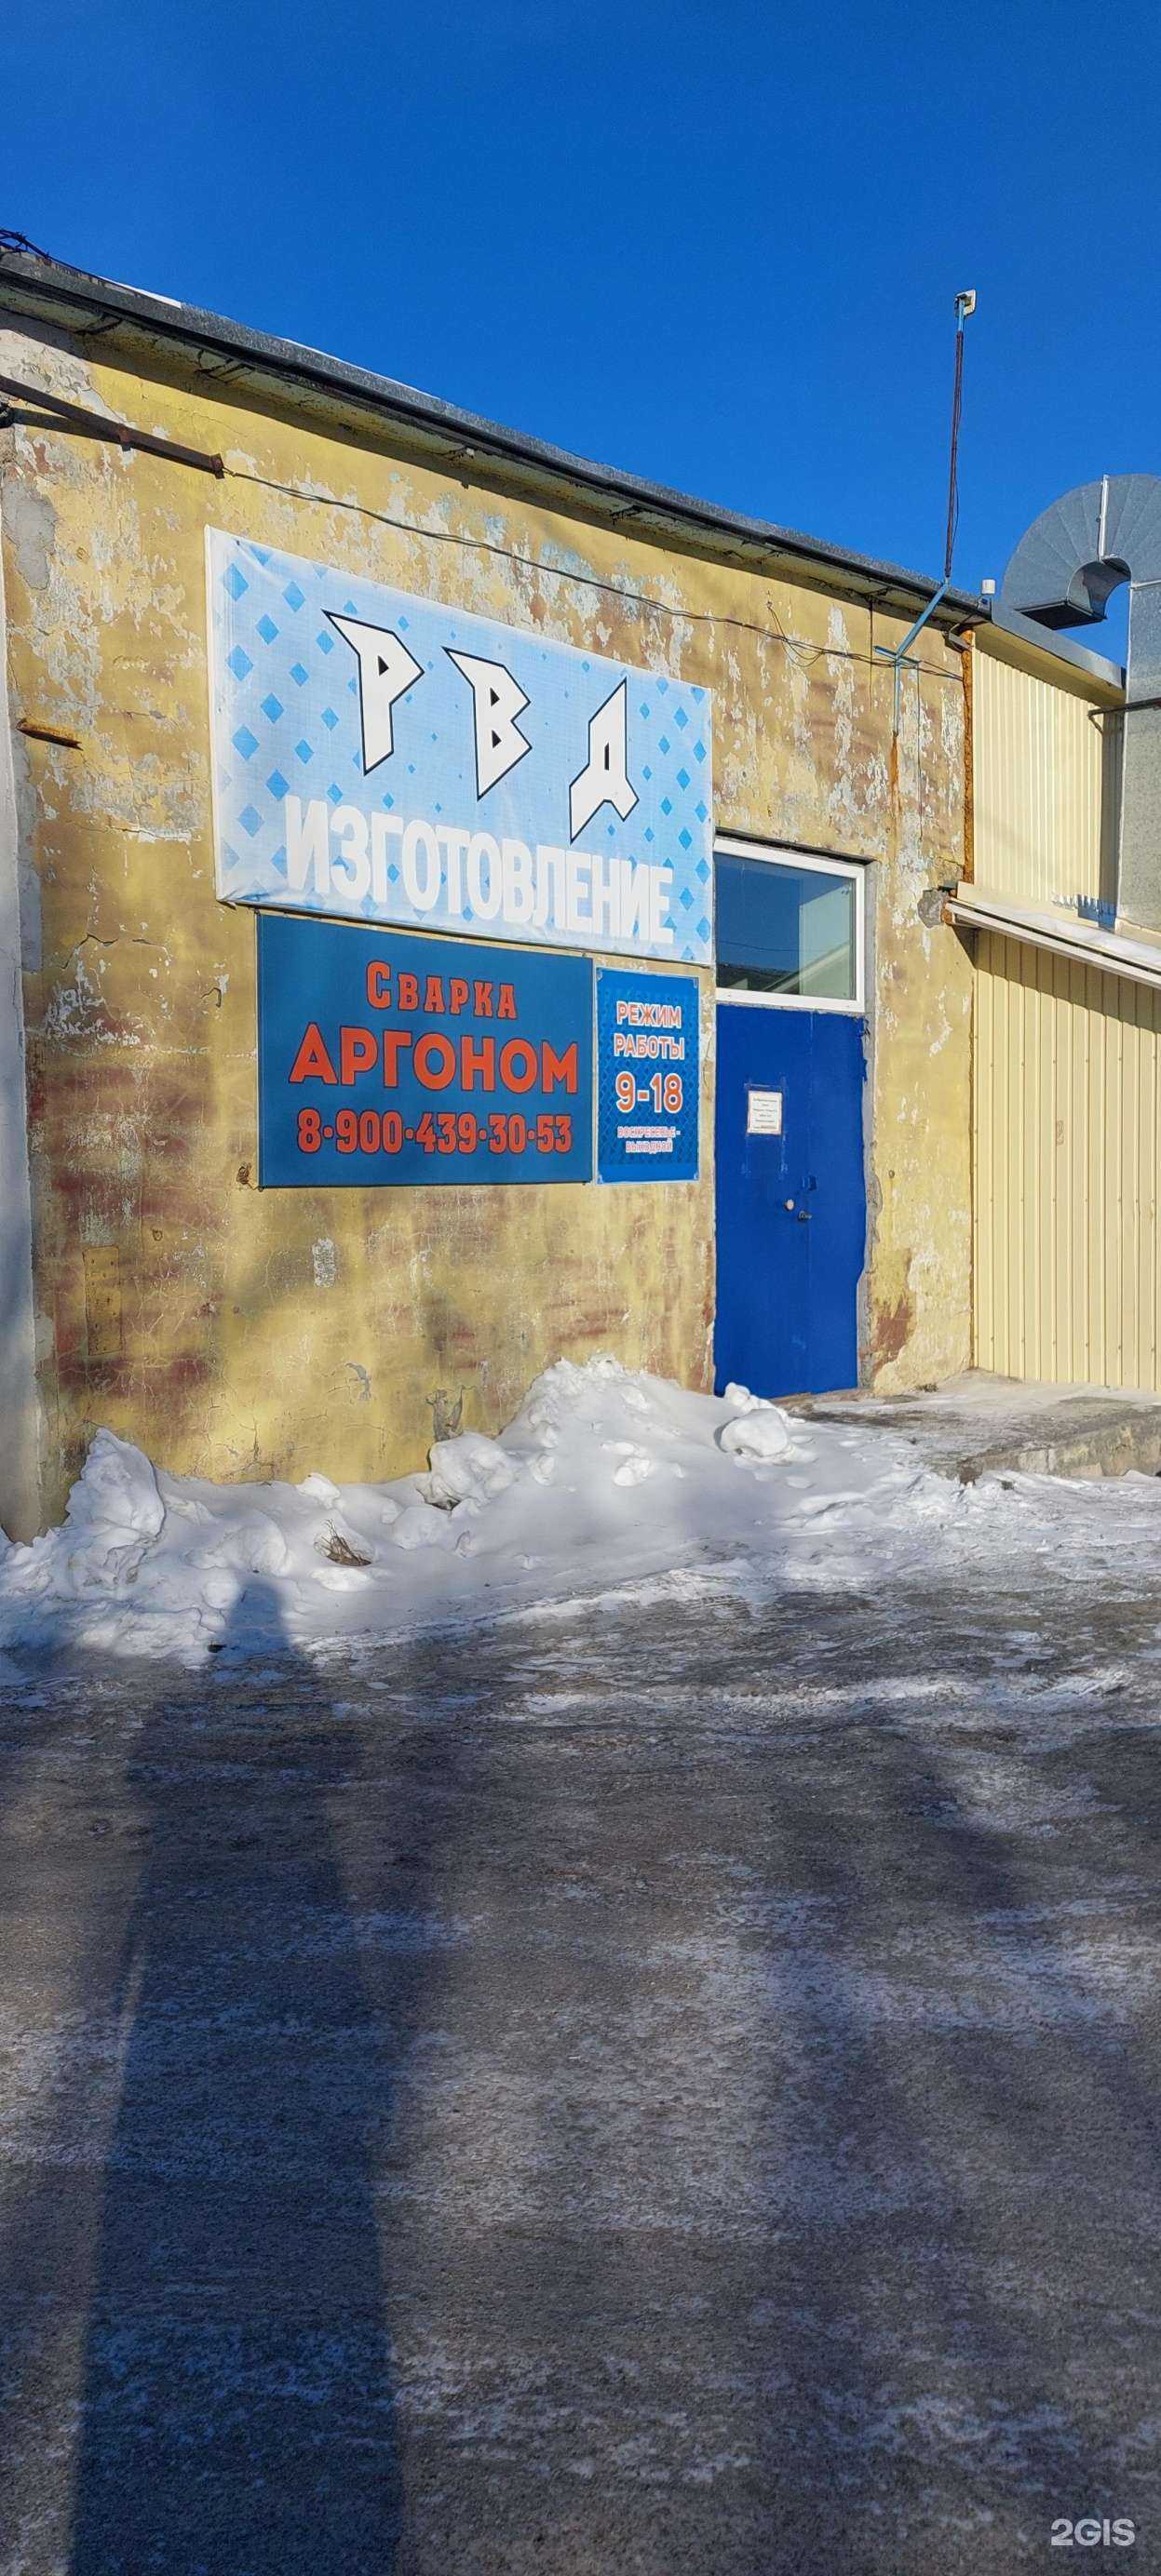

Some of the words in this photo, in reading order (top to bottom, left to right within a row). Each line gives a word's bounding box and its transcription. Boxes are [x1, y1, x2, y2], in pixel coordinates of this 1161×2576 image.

[285, 795, 674, 945] ИЗГОТОВЛЕНИЕ
[616, 1001, 682, 1028] РЕЖИМ
[289, 1021, 579, 1094] АРГОНОМ
[614, 1033, 685, 1060] РАБОТЫ
[615, 1070, 683, 1113] 9-18
